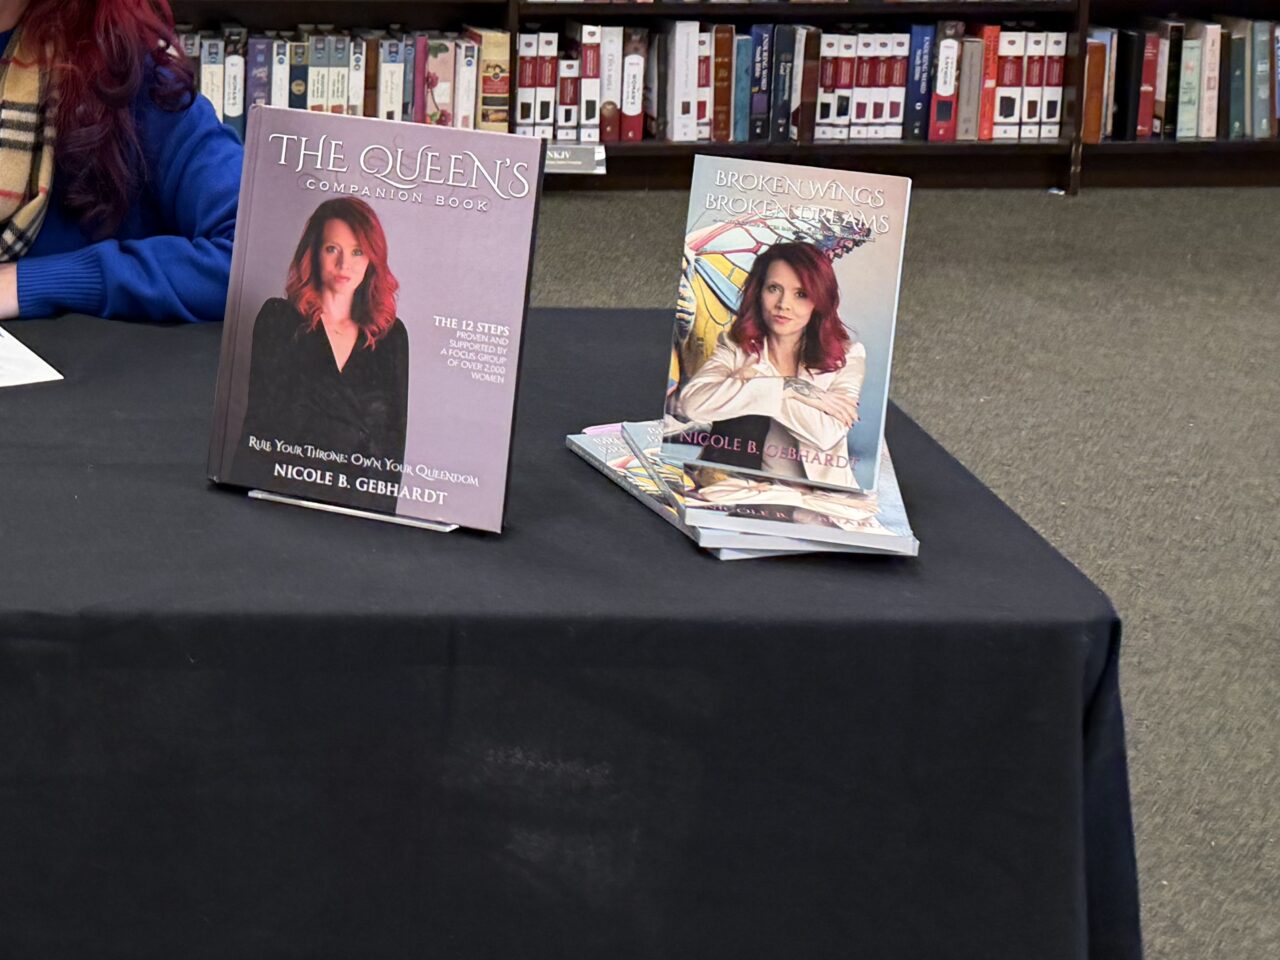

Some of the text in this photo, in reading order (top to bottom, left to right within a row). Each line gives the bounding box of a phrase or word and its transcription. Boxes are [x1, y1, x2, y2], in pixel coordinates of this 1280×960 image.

[547, 151, 571, 159] NKJV
[268, 132, 531, 201] THE QUEEN'S
[306, 178, 489, 213] COMPANION BOOK
[715, 170, 886, 208] BROKEN WINGS
[705, 192, 795, 220] BROKEN
[795, 204, 890, 235] DREAMS
[433, 316, 510, 336] THE 12 STEPS
[449, 340, 508, 355] SUPPORTED BY
[456, 331, 509, 346] PROVEN AND
[447, 359, 460, 367] OF
[460, 360, 483, 370] OVER
[448, 348, 476, 360] FOCUS
[478, 353, 507, 363] GROUP
[471, 371, 505, 384] WOMEN
[679, 431, 861, 470] NICOLE B. GEBHARDT
[274, 462, 448, 506] NICOLE B. GEBHARDT
